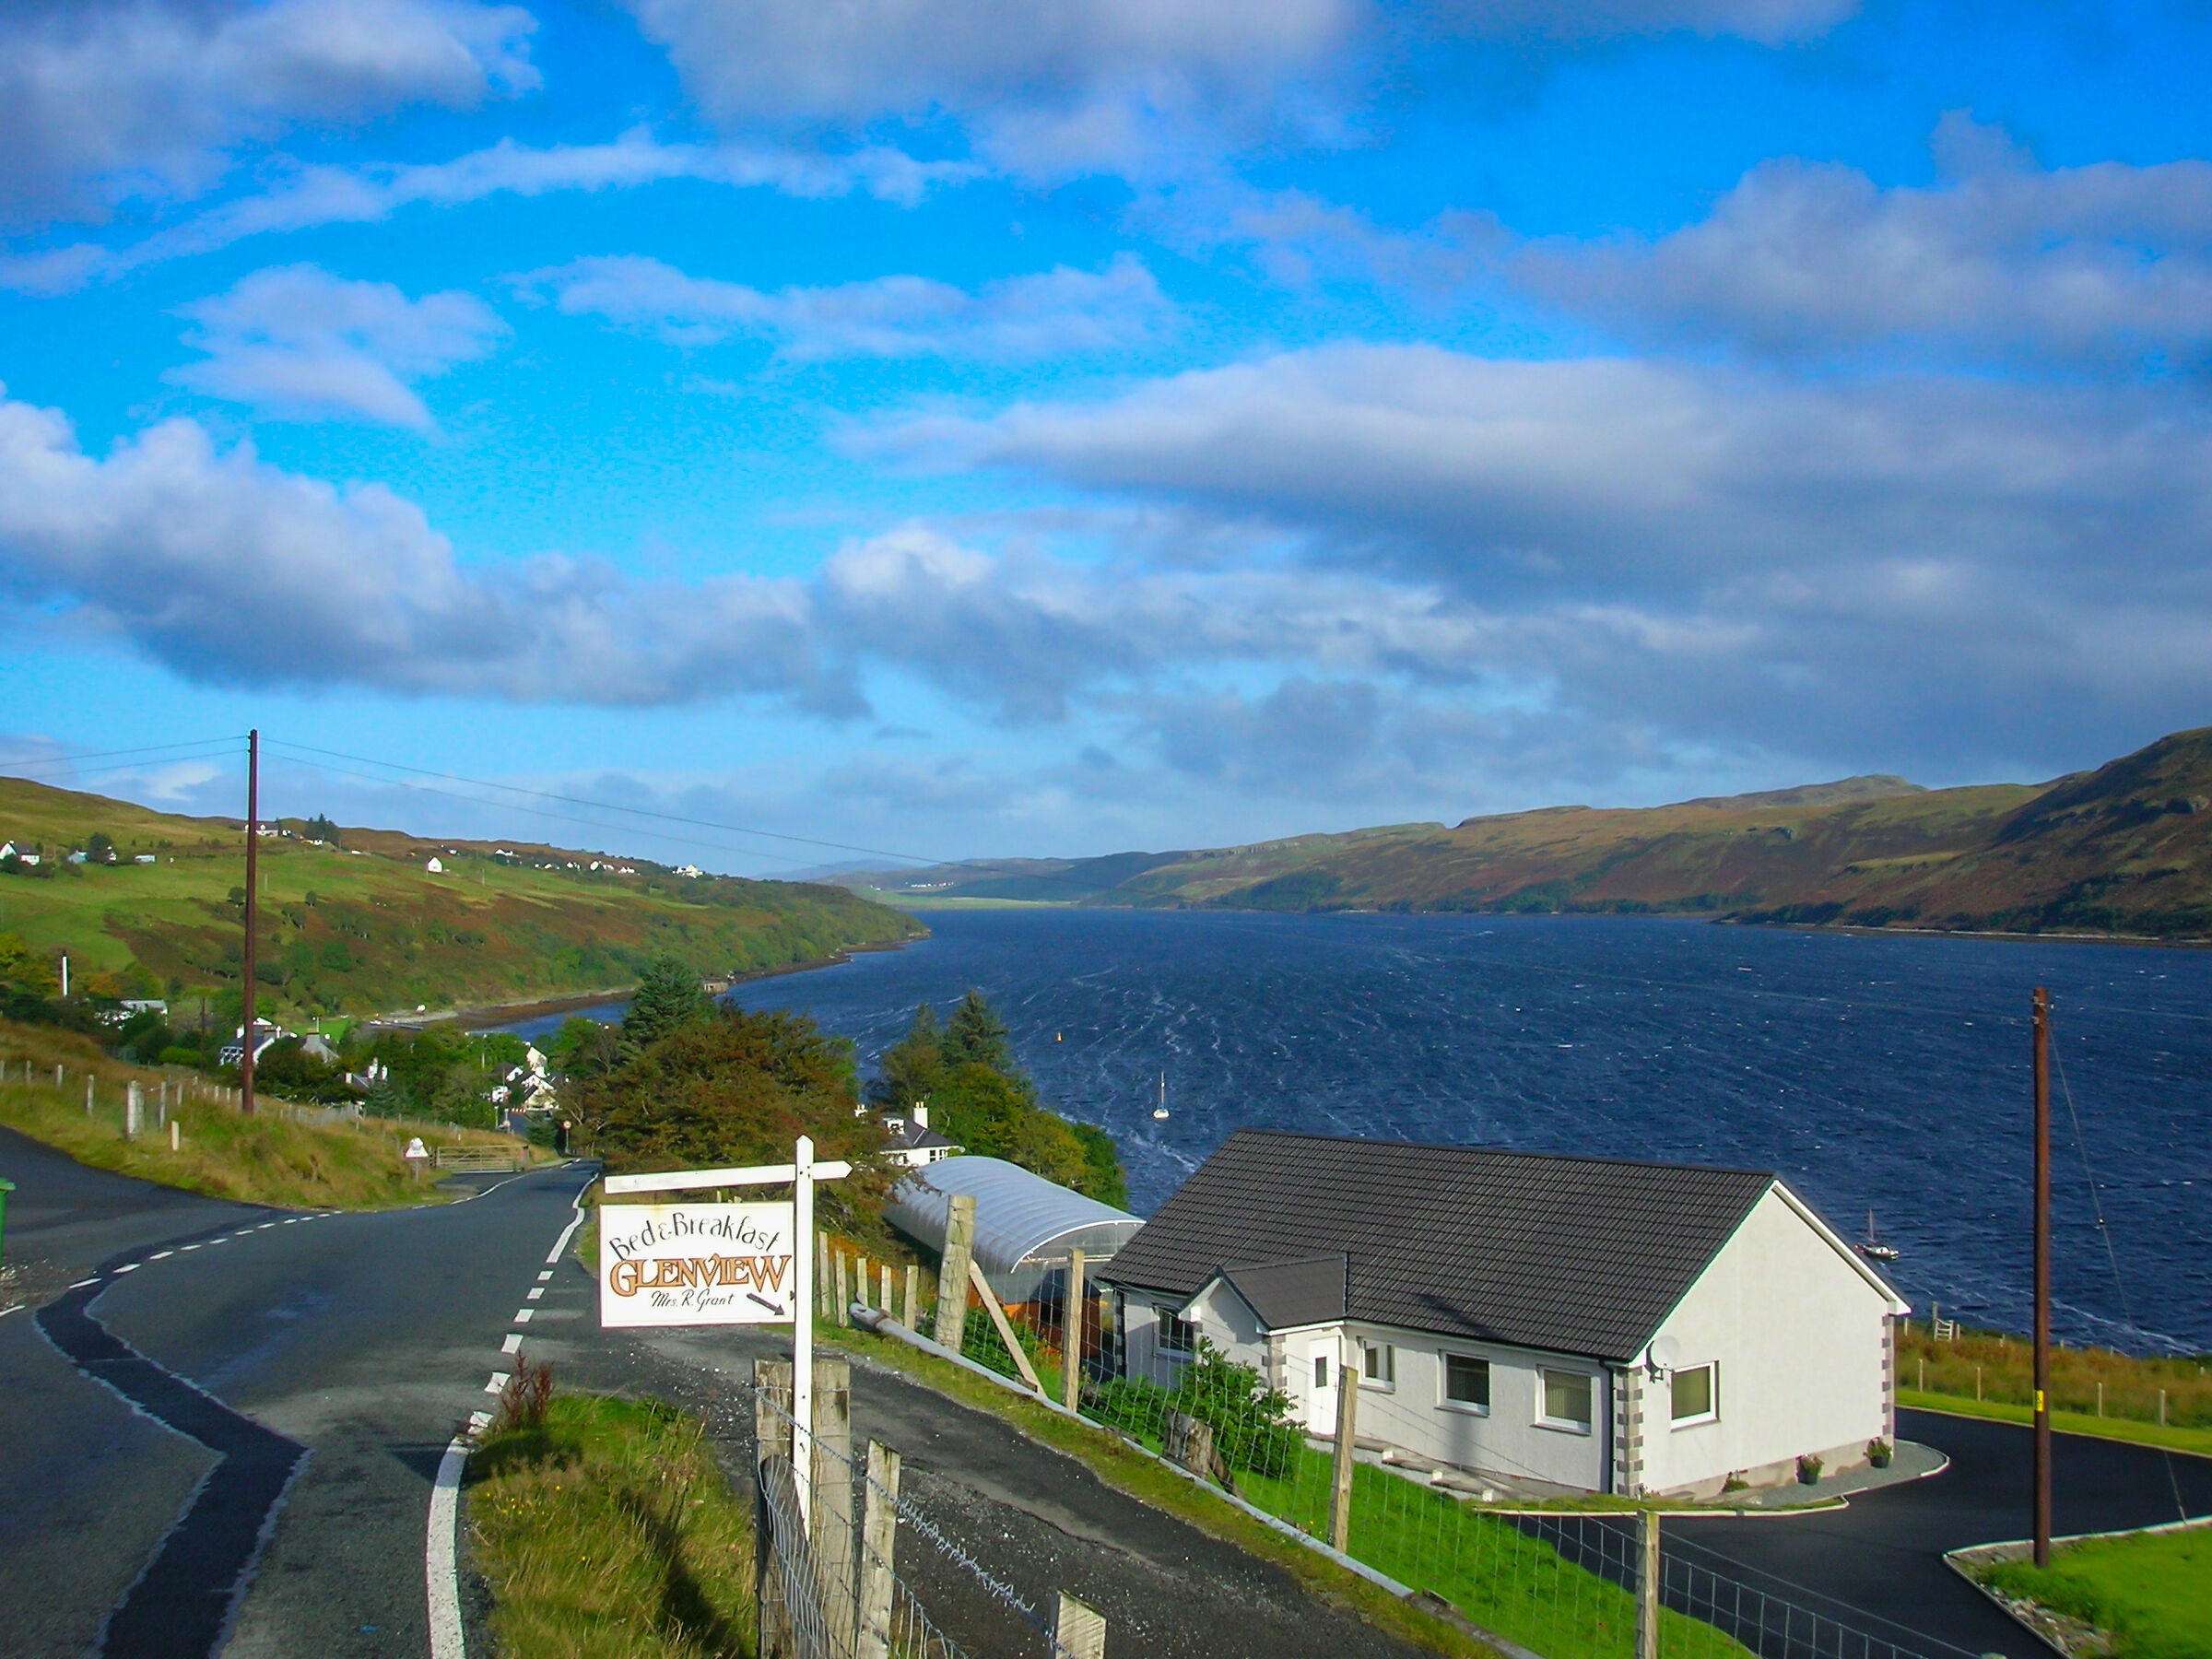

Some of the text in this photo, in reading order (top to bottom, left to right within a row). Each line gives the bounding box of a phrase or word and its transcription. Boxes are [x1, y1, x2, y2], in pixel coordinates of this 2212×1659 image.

[609, 1220, 655, 1260] Bed
[672, 1212, 780, 1253] Breakfast
[610, 1253, 792, 1297] GLENVIEW
[696, 1288, 735, 1312] Grant
